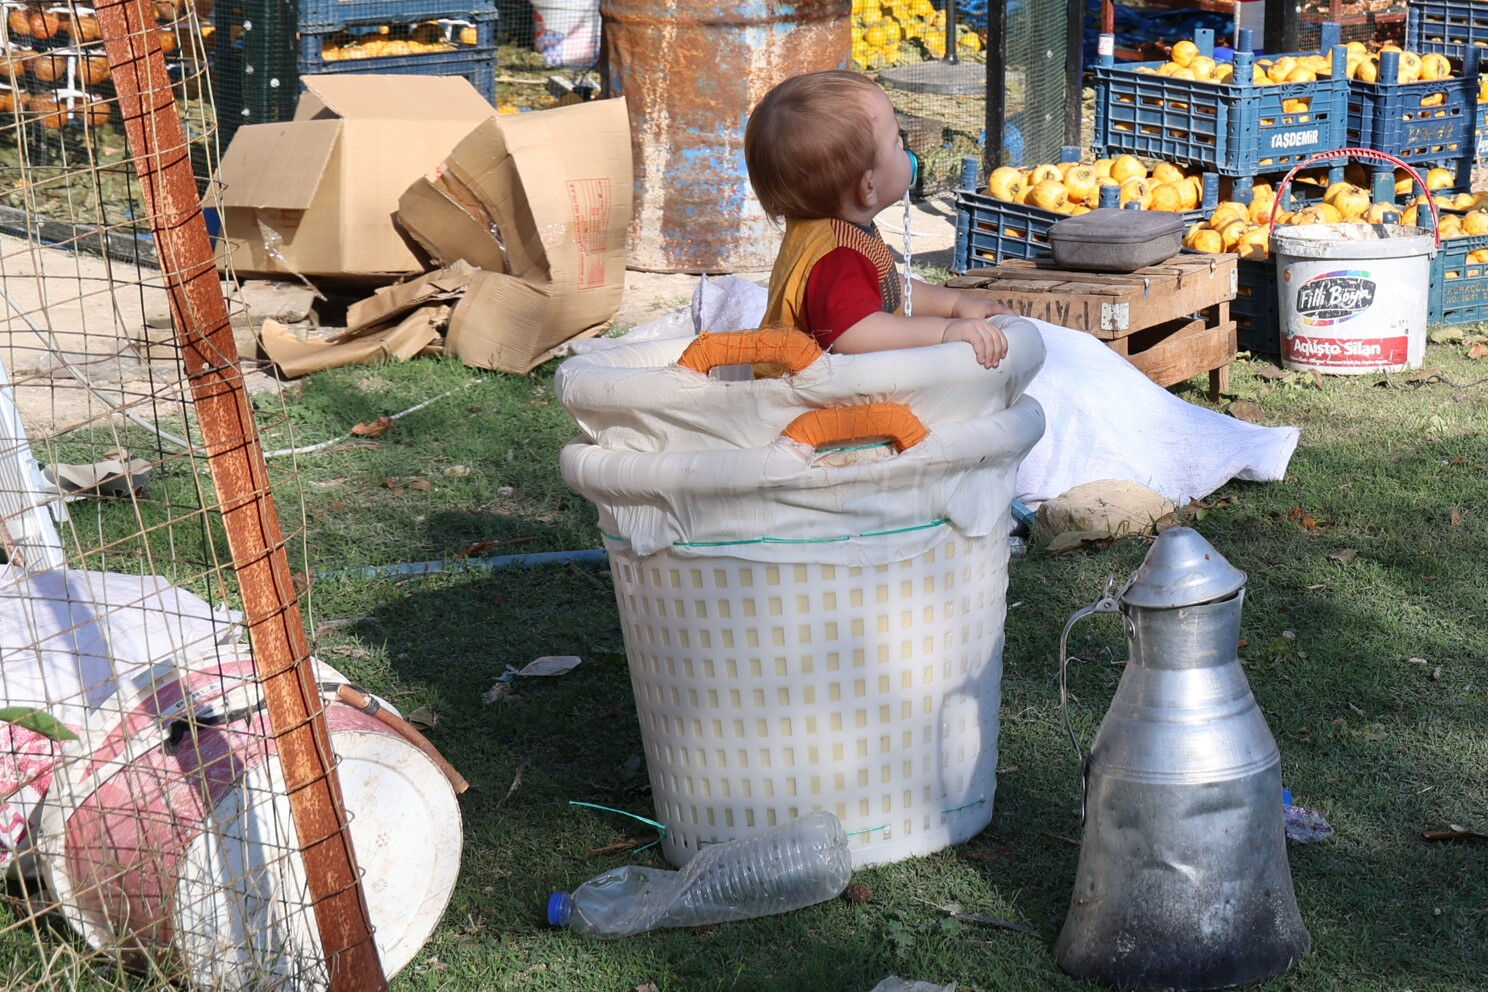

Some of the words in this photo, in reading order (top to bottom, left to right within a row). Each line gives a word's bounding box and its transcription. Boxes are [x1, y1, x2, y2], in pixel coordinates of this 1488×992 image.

[1301, 286, 1326, 309] Filli
[1329, 285, 1372, 309] Boya
[1344, 341, 1381, 356] Silan
